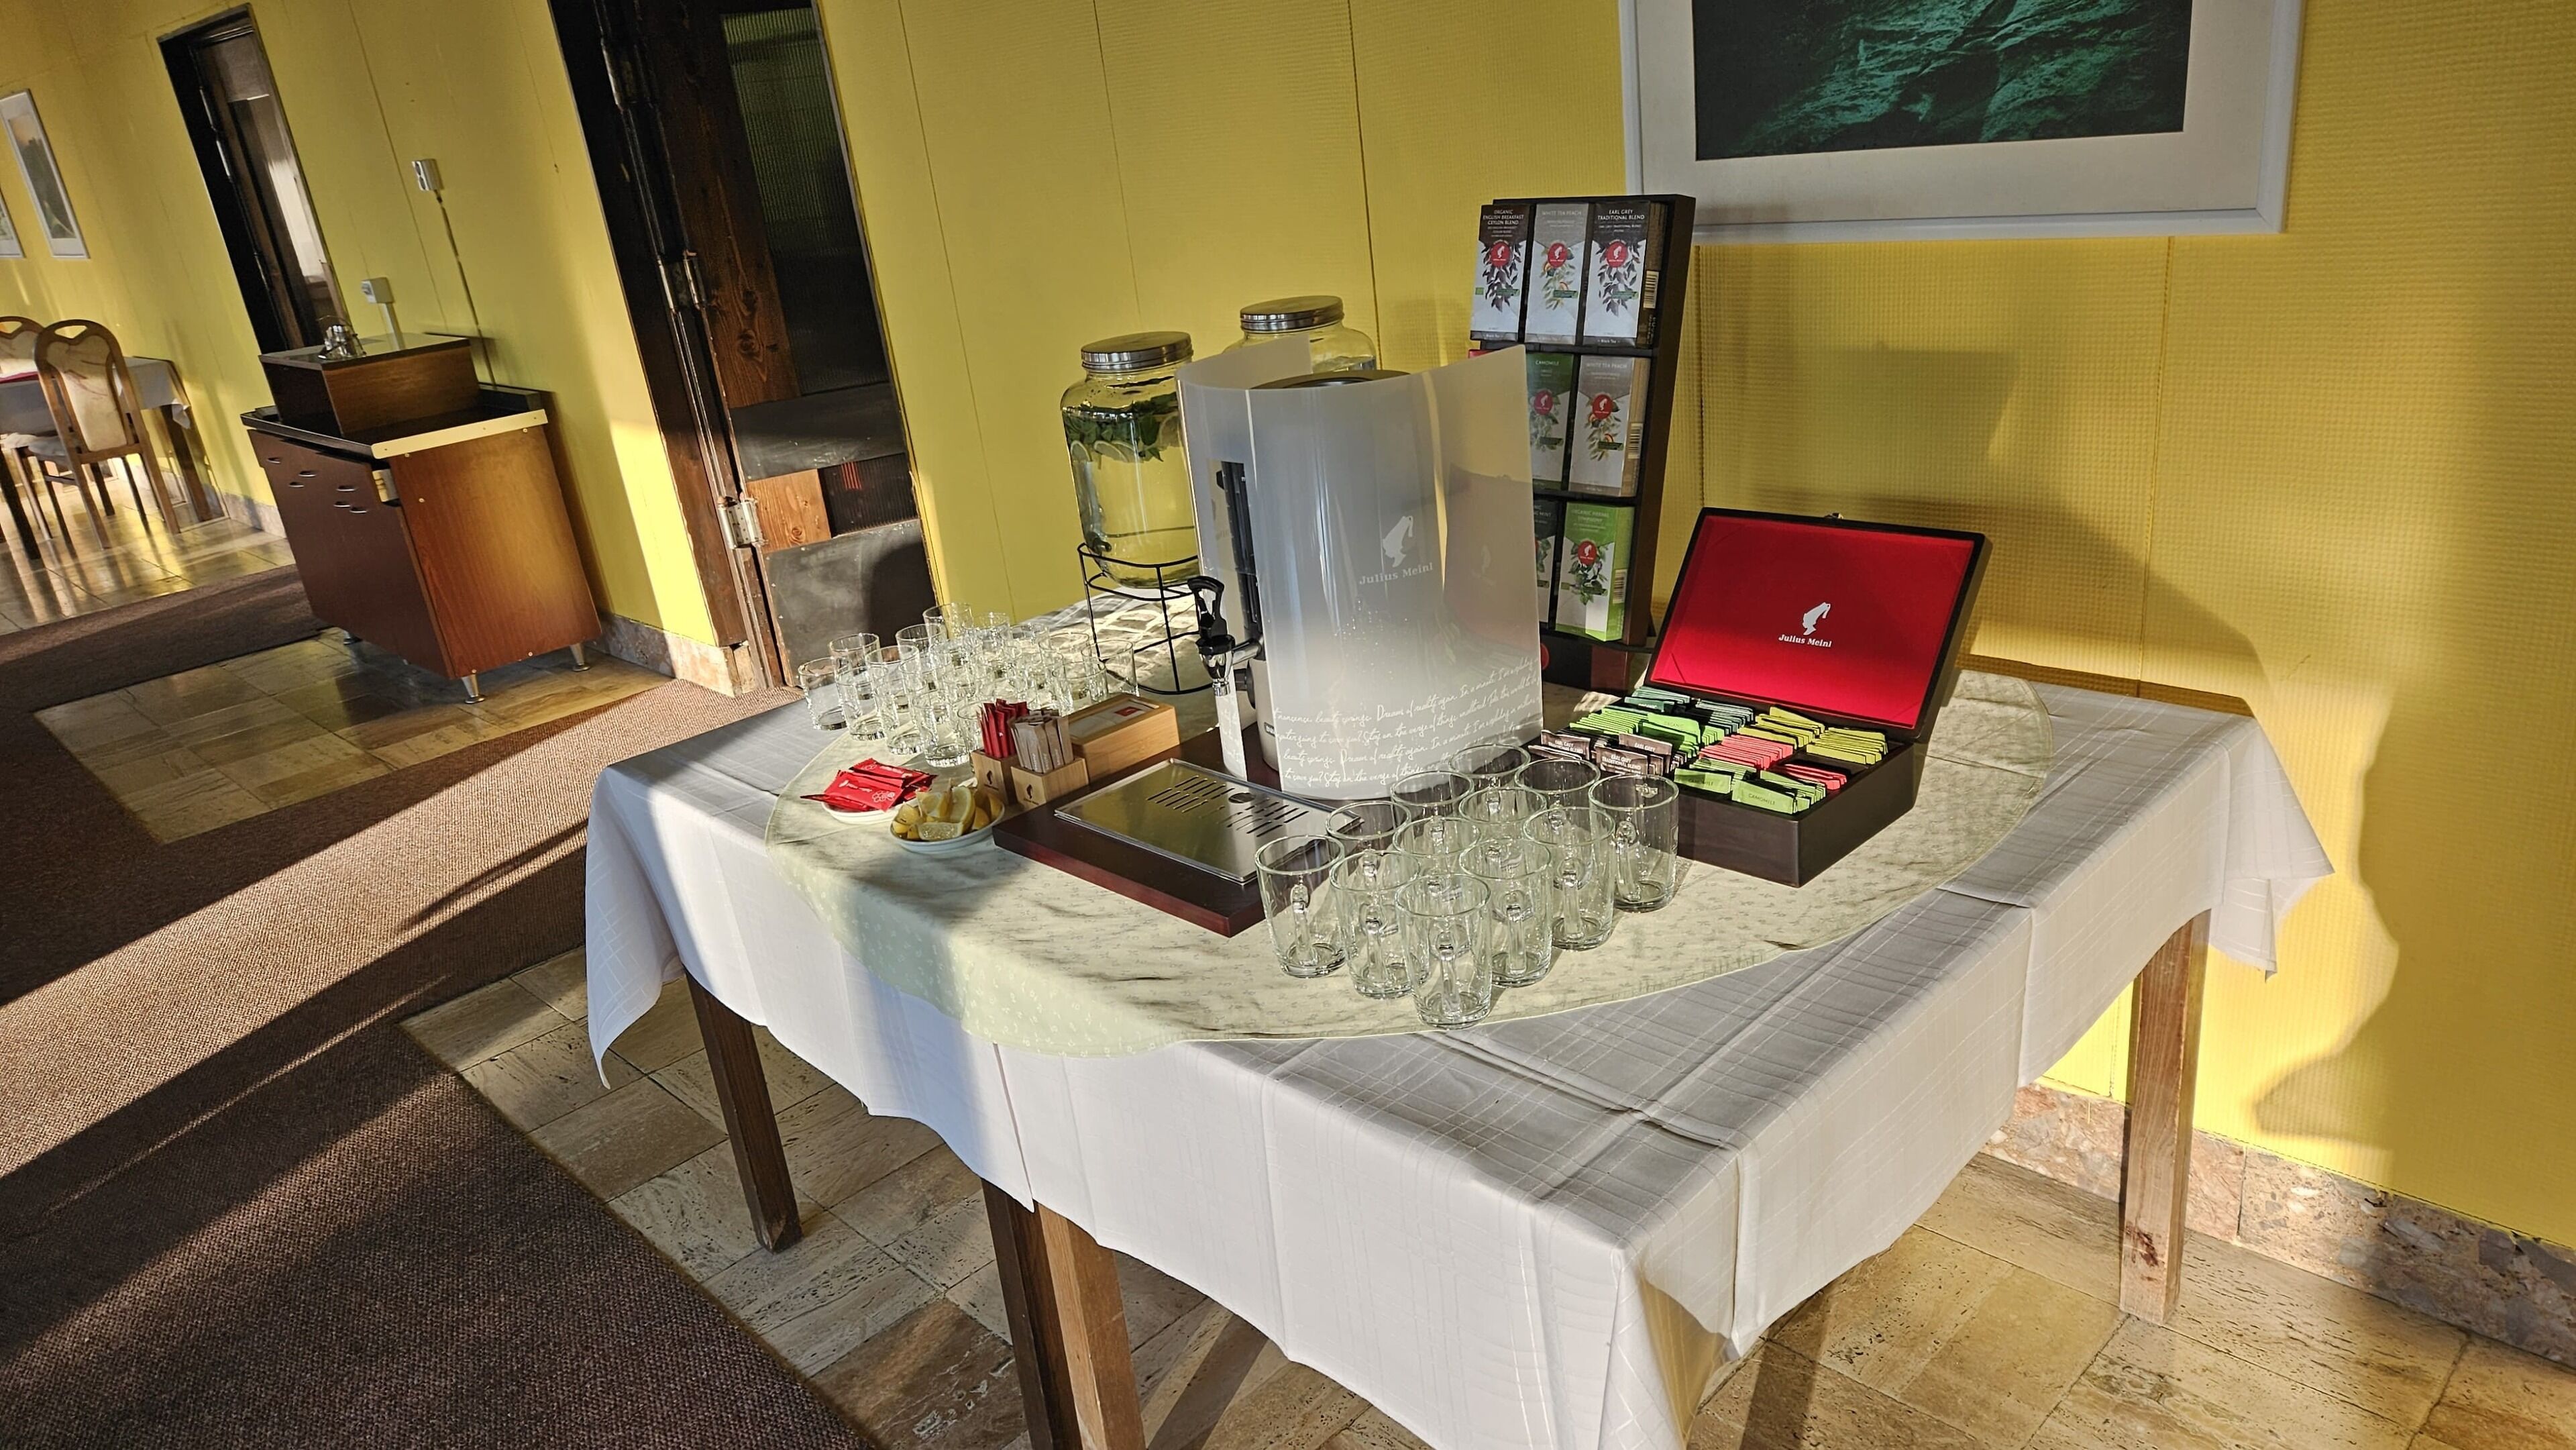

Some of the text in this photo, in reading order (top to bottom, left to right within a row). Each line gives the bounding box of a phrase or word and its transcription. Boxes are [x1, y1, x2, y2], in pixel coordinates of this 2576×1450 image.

[1359, 562, 1434, 585] Julius Meinl
[1778, 634, 1832, 648] Julius Meinl
[1377, 704, 1404, 721] Dream
[1405, 700, 1413, 718] of
[1369, 747, 1378, 765] of
[1602, 756, 1627, 767] TRADITIONAL
[1748, 793, 1776, 805] CAMOMILE
